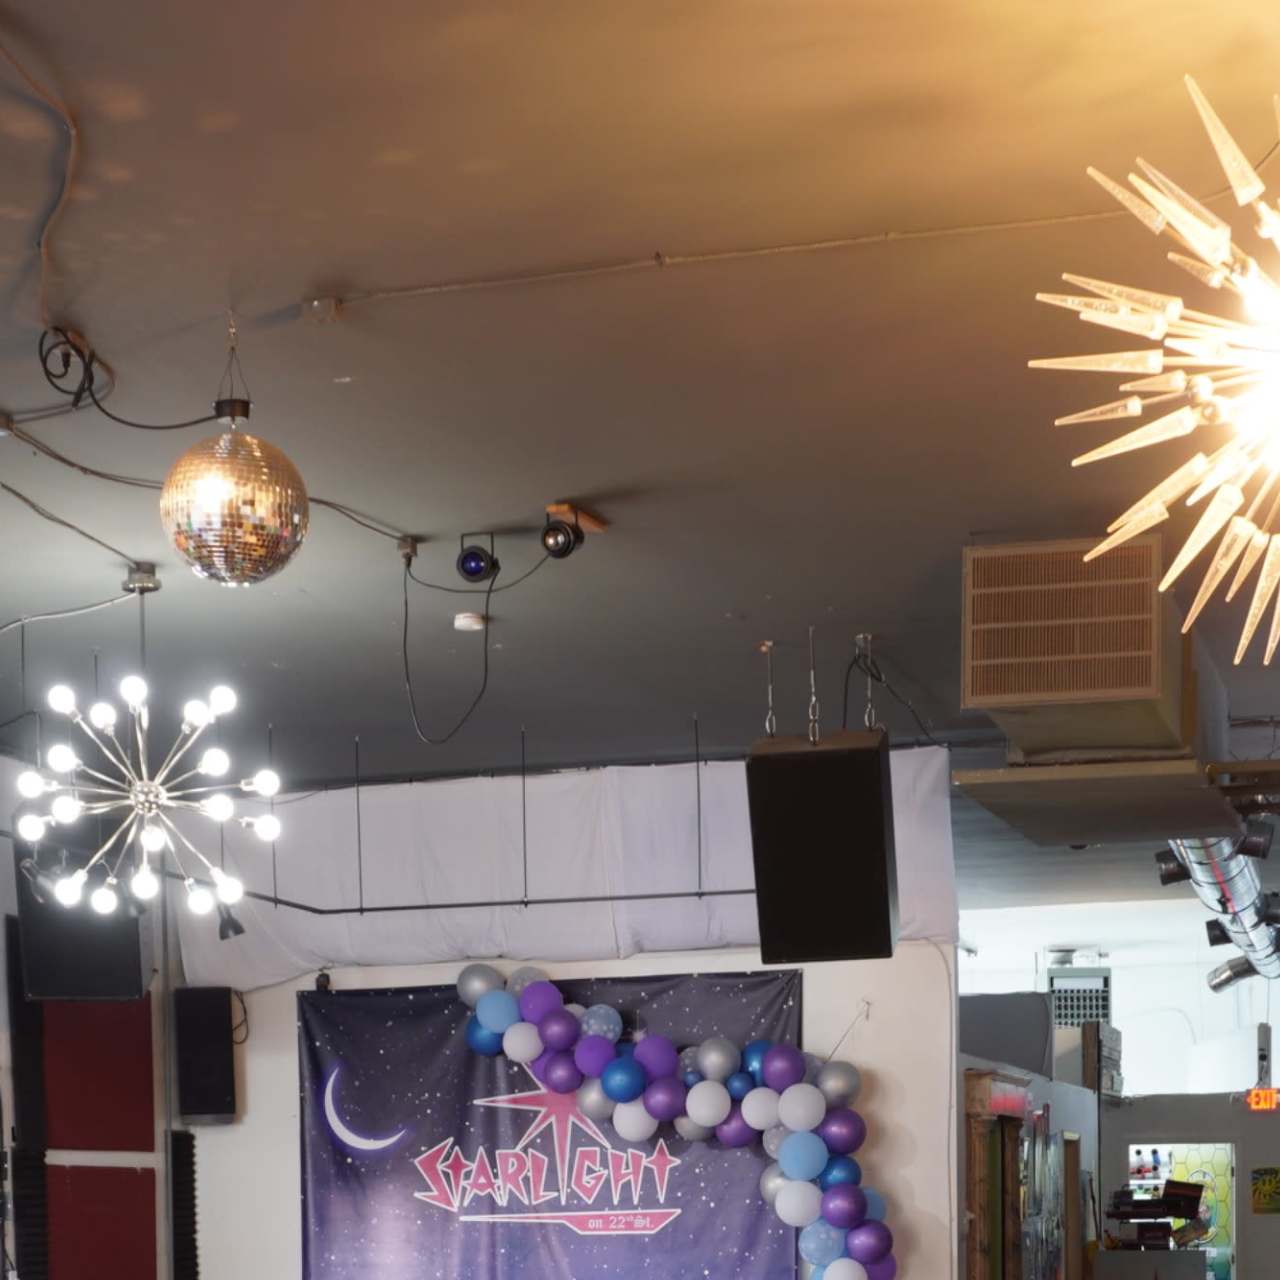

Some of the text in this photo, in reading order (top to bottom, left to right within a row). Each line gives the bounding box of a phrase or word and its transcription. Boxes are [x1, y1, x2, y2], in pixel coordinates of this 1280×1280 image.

[1249, 1088, 1280, 1111] EXIT
[414, 1137, 681, 1212] STARLIGHT
[588, 1219, 602, 1229] on
